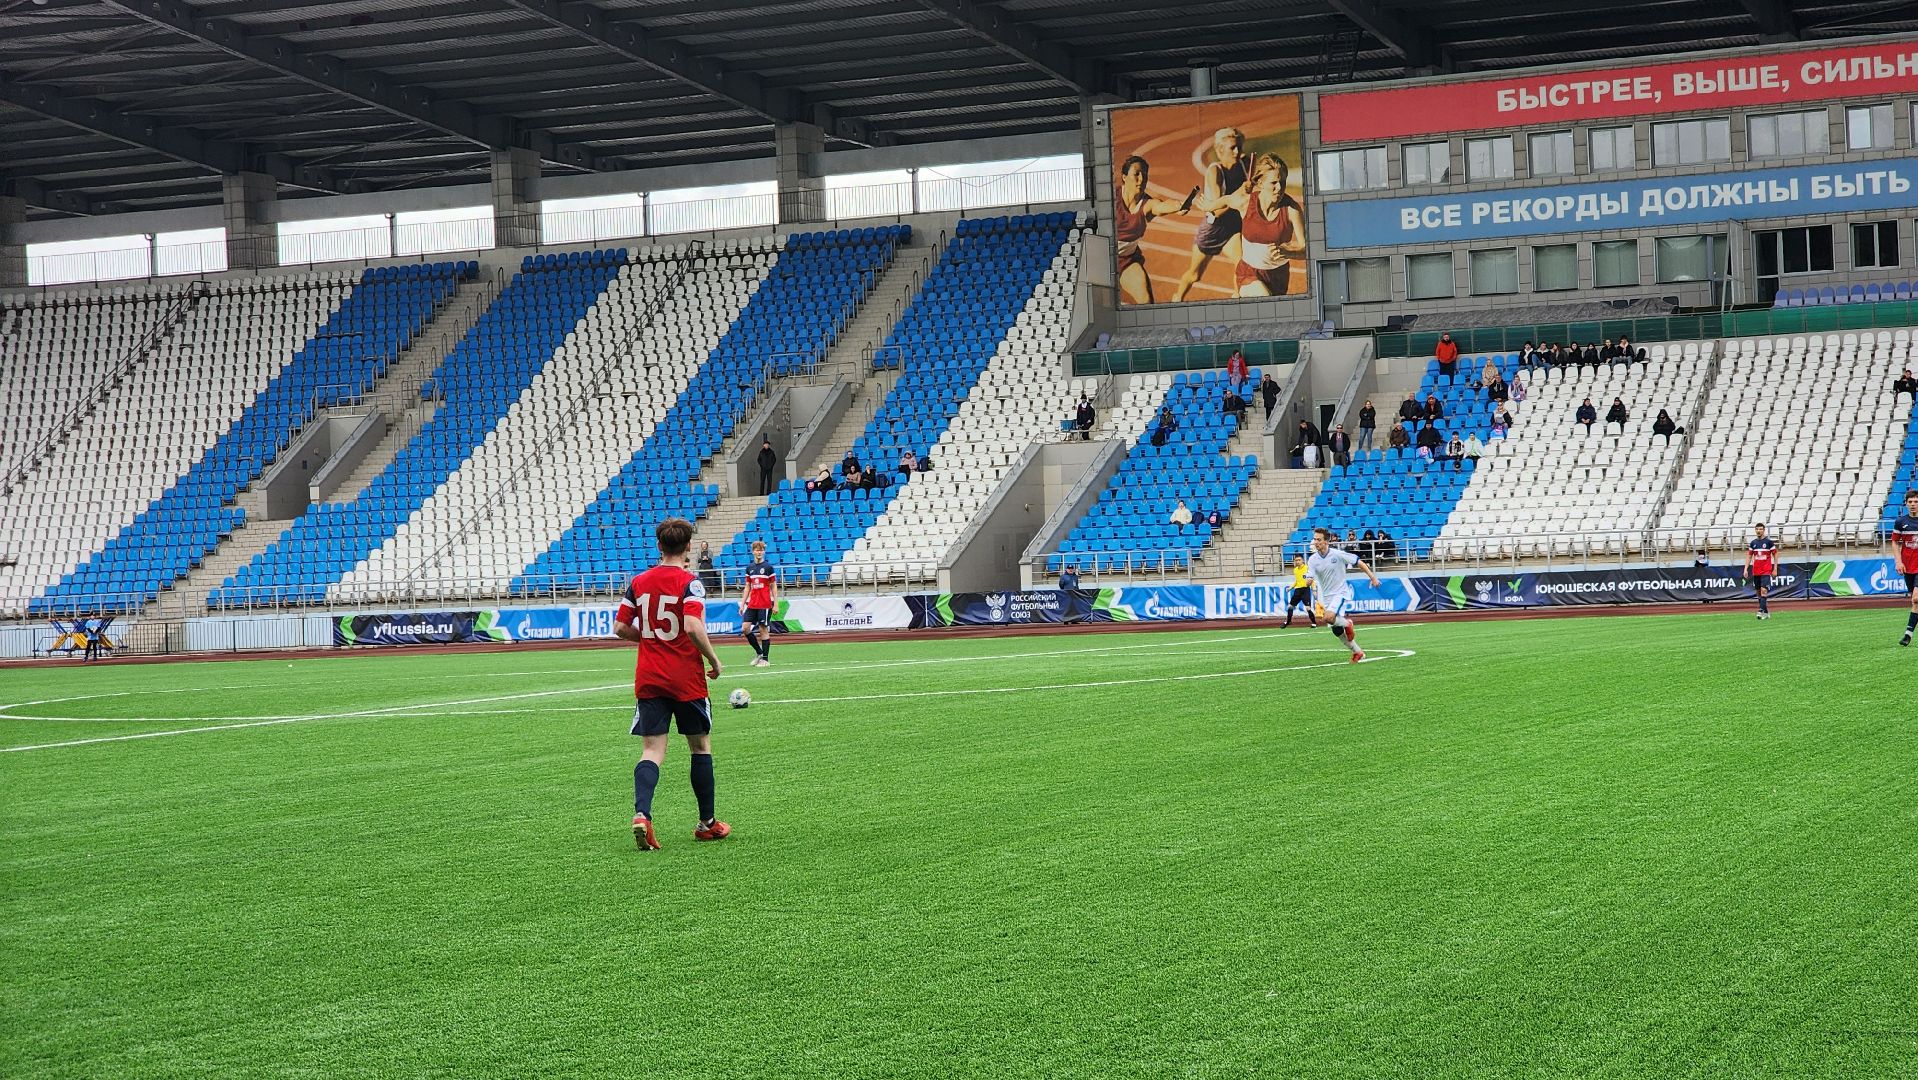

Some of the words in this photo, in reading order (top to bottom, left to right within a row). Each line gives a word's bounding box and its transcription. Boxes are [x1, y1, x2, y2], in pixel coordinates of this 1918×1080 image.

[1497, 76, 1662, 112] БЫСТРЕЕ,
[1673, 65, 1790, 96] ВЫШЕ,
[1801, 52, 1918, 85] СИЛЬН
[1401, 204, 1461, 230] ВСЕ
[1472, 191, 1629, 225] РЕКОРДЫ
[1640, 177, 1799, 217] ДОЛЖНЫ
[1811, 170, 1910, 200] БЫТЬ
[1535, 581, 1616, 594] ЮНОШЕСКАЯ
[1618, 578, 1701, 591] ФУТБОЛЬНАЯ
[1704, 577, 1736, 588] ЛИГА
[1010, 592, 1057, 602] РОССИЙСКИЙ
[1215, 586, 1305, 615] ГАЗПРО
[1010, 601, 1059, 611] ФУТБОЛЬНЫЙ
[1159, 606, 1197, 617] ГАЗПРОМ
[1353, 599, 1394, 610] ГАЗПРОМ
[636, 593, 680, 641] 15
[1010, 611, 1031, 619] СОЮЗ
[373, 622, 453, 639] yflrussia.ru
[530, 627, 563, 638] ГАЗПРОМ
